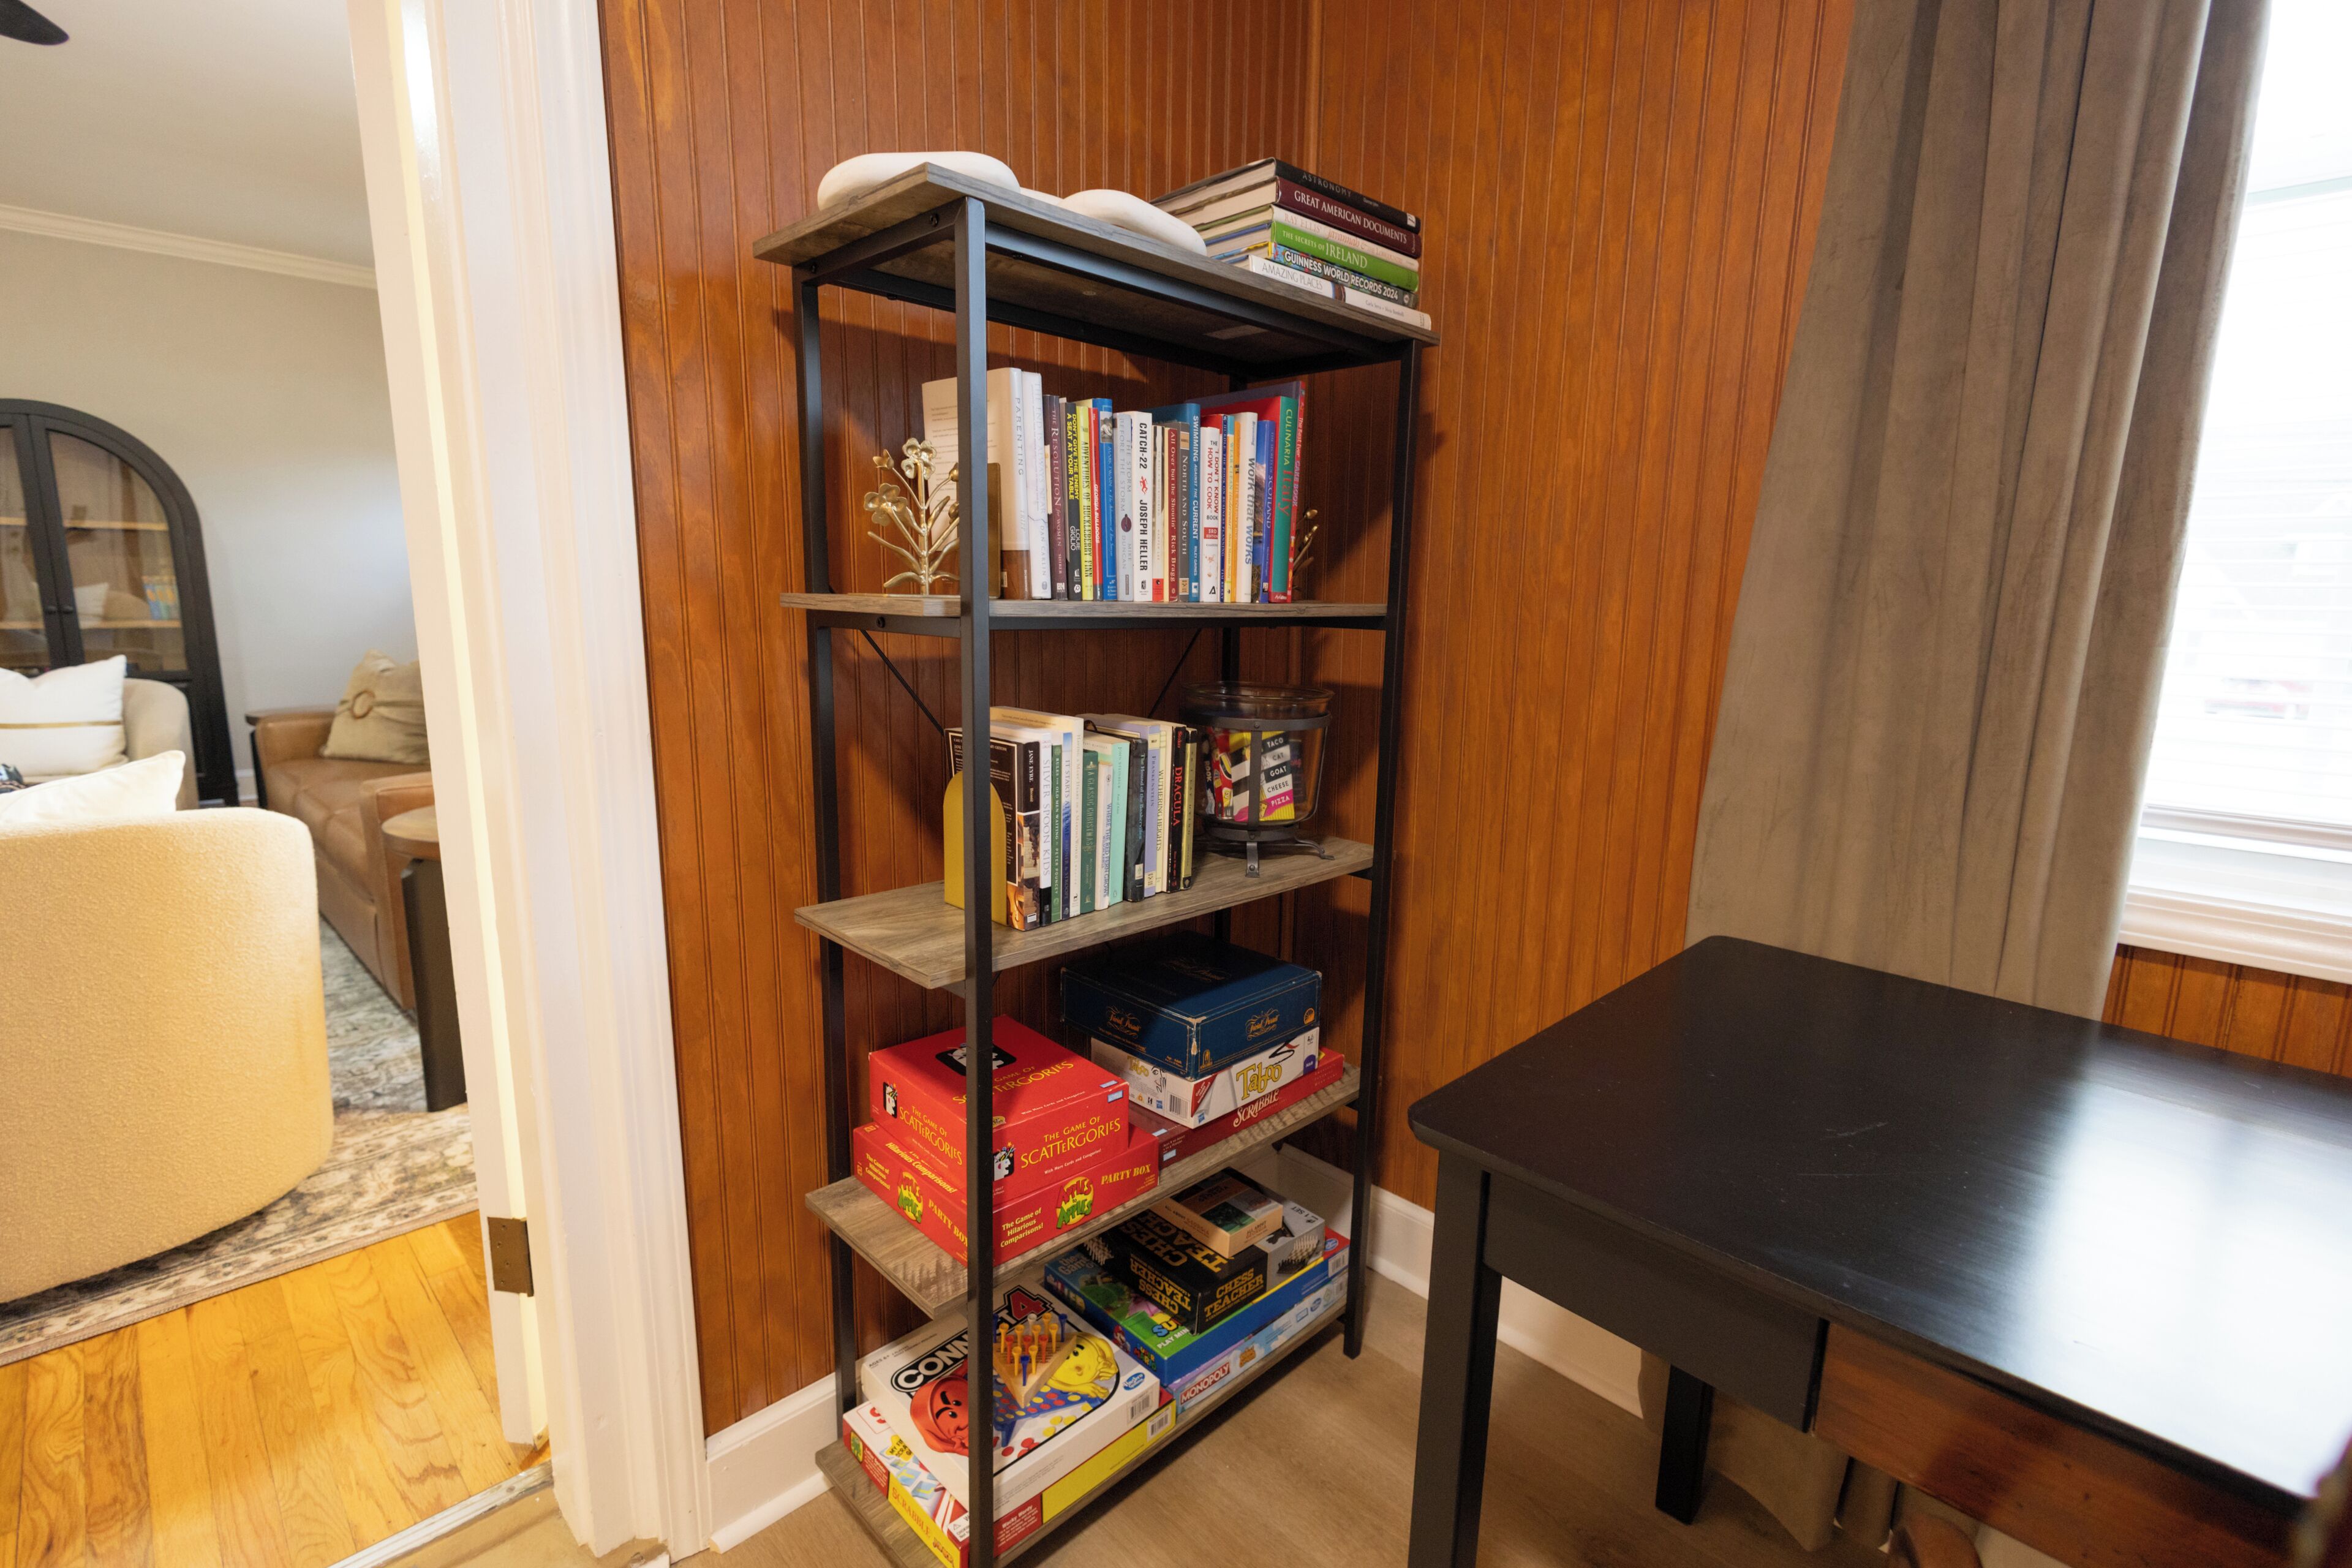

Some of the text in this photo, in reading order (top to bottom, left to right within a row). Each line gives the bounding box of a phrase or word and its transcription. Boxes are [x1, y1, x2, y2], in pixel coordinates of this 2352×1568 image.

[1302, 172, 1352, 197] ASTRONOMY
[1294, 190, 1320, 209] GREAT
[1322, 201, 1361, 225] AMERICAN
[1363, 217, 1408, 244] DOCUMENTS
[1283, 230, 1293, 241] THE
[1294, 233, 1317, 248] SECRETS
[1318, 243, 1325, 252] OF
[1325, 243, 1367, 269] IRELAND
[1262, 262, 1323, 291] AMAZING PLACES
[1285, 251, 1398, 300] GUINNESS WORLD RECORDS 2024
[1015, 398, 1024, 475] PARENTING
[1068, 443, 1072, 454] AT
[1139, 423, 1148, 469] CATCH-22
[1051, 428, 1061, 506] RESOLUTION
[1207, 472, 1213, 483] TO
[1278, 409, 1294, 516] CULINARIA Italy
[1083, 492, 1090, 502] OF
[1246, 494, 1255, 524] that
[1083, 505, 1092, 559] HUCKLEBERRY
[1139, 499, 1148, 535] JOSEPH
[1245, 525, 1254, 565] works
[1267, 737, 1284, 748] TACO
[1273, 752, 1284, 761] CAT
[1267, 780, 1289, 793] CHEESE
[1270, 766, 1287, 777] GOAT
[1065, 800, 1070, 809] AT
[1172, 766, 1183, 826] DRACULA
[1271, 795, 1290, 807] PIZZA
[1086, 807, 1095, 846] CHRISTMAS
[994, 1071, 1020, 1082] GAME
[1127, 1055, 1150, 1077] Taboo
[1236, 1063, 1282, 1101] Taboo
[911, 1106, 947, 1137] THE GAME OF
[1233, 1088, 1279, 1128] SCRABBLE
[899, 1106, 962, 1166] SCATTERGORIES
[1020, 1118, 1121, 1169] SCATTERGORIES
[1044, 1116, 1101, 1142] THE GAME OF
[873, 1158, 885, 1172] Game
[885, 1142, 913, 1163] Hilarious
[912, 1161, 957, 1194] Comparisons!
[1054, 1164, 1063, 1172] More
[1082, 1148, 1102, 1160] Categories!
[1101, 1169, 1132, 1185] PARTY
[1133, 1164, 1152, 1177] BOX
[1055, 1177, 1093, 1208] APPLES
[929, 1199, 953, 1229] PARTY
[1001, 1207, 1042, 1231] The Game of
[1007, 1218, 1037, 1237] Hilarious
[1056, 1198, 1093, 1230] APPLES
[1000, 1223, 1044, 1248] Comparisons!
[1130, 1257, 1191, 1312] TEACHER
[1138, 1277, 1178, 1315] CHESS
[1204, 1273, 1264, 1317] TEACHER
[1215, 1268, 1254, 1299] CHESS
[1010, 1290, 1045, 1321] 4
[1156, 1336, 1175, 1349] PLAY
[1180, 1363, 1230, 1404] MONOPOLY
[892, 1487, 930, 1536] SCRABBLE
